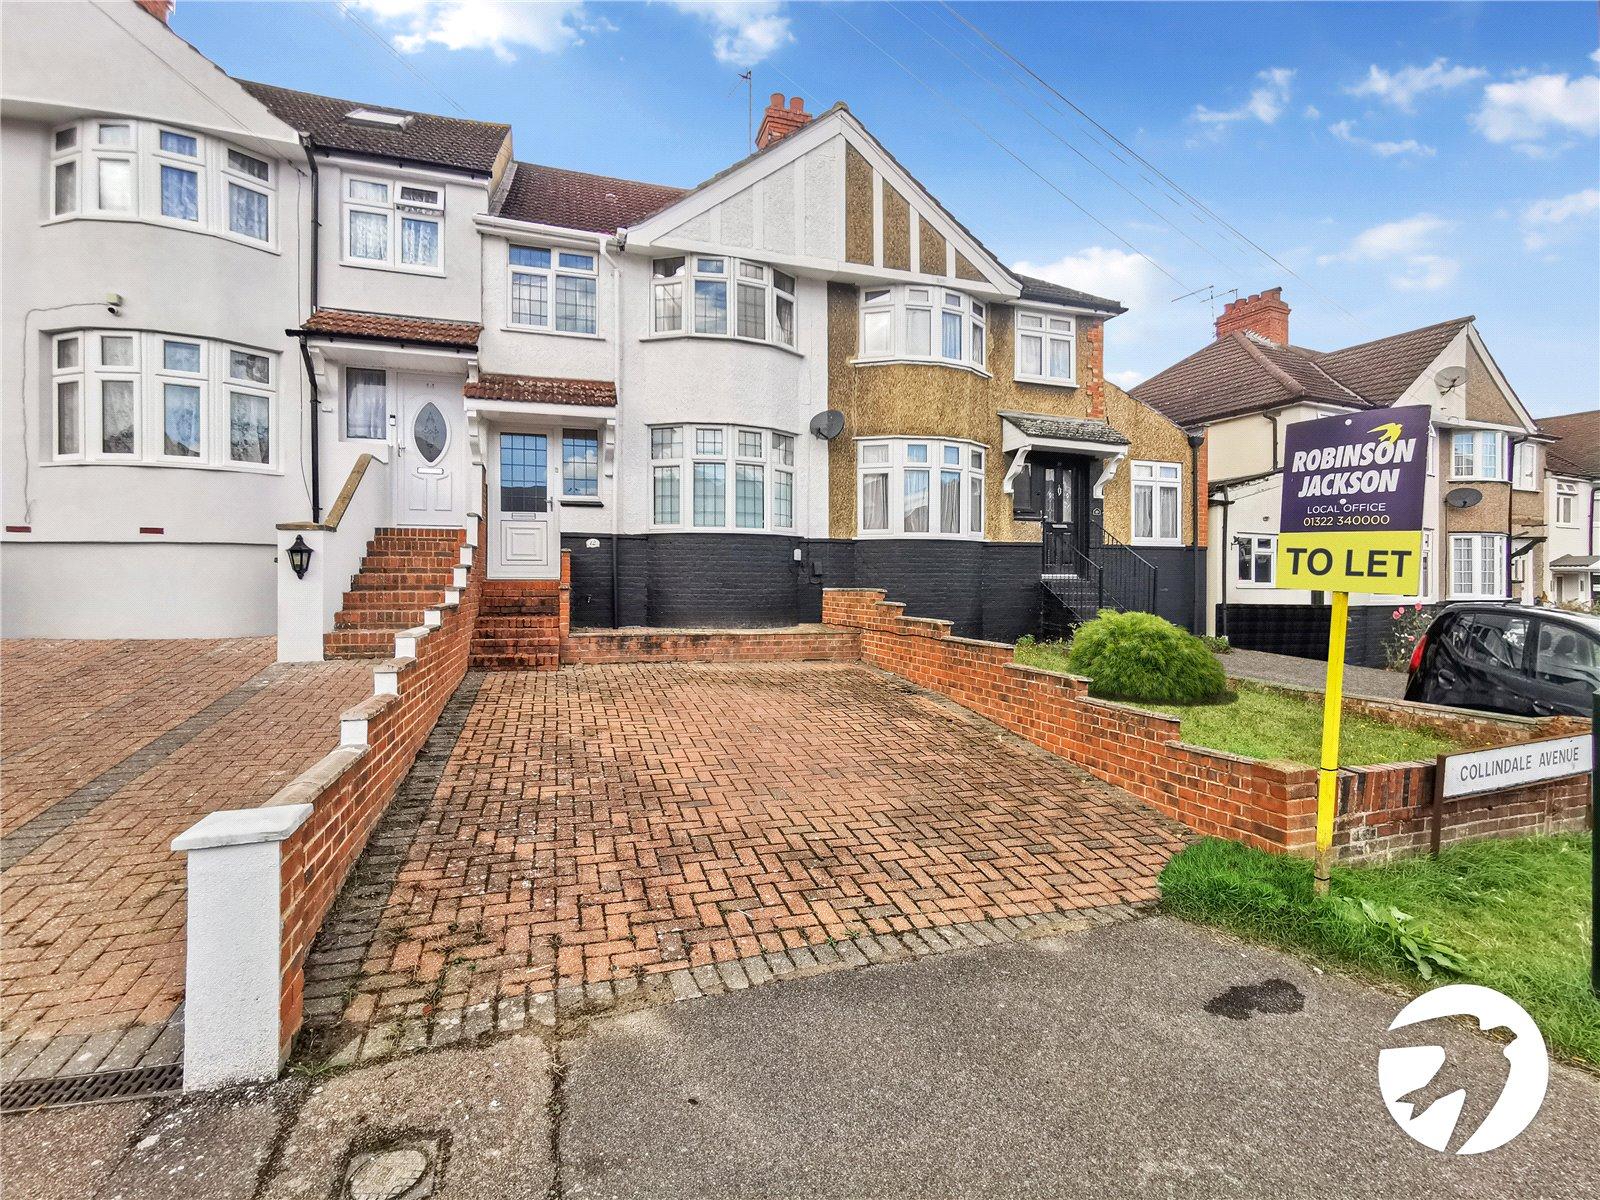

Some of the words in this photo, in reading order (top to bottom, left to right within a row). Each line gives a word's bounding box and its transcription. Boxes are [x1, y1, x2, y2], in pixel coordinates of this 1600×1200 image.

[1292, 438, 1416, 473] ROBINSON
[1298, 468, 1400, 497] JACKSON
[1303, 516, 1334, 526] 01322
[1337, 515, 1390, 525] 340000
[1307, 504, 1340, 514] LOCAL
[1343, 502, 1386, 513] OFFICE
[1286, 547, 1333, 576] TO
[1345, 549, 1412, 577] LET
[1460, 755, 1532, 781] COLLINDALE
[1538, 747, 1579, 768] AVENUE
